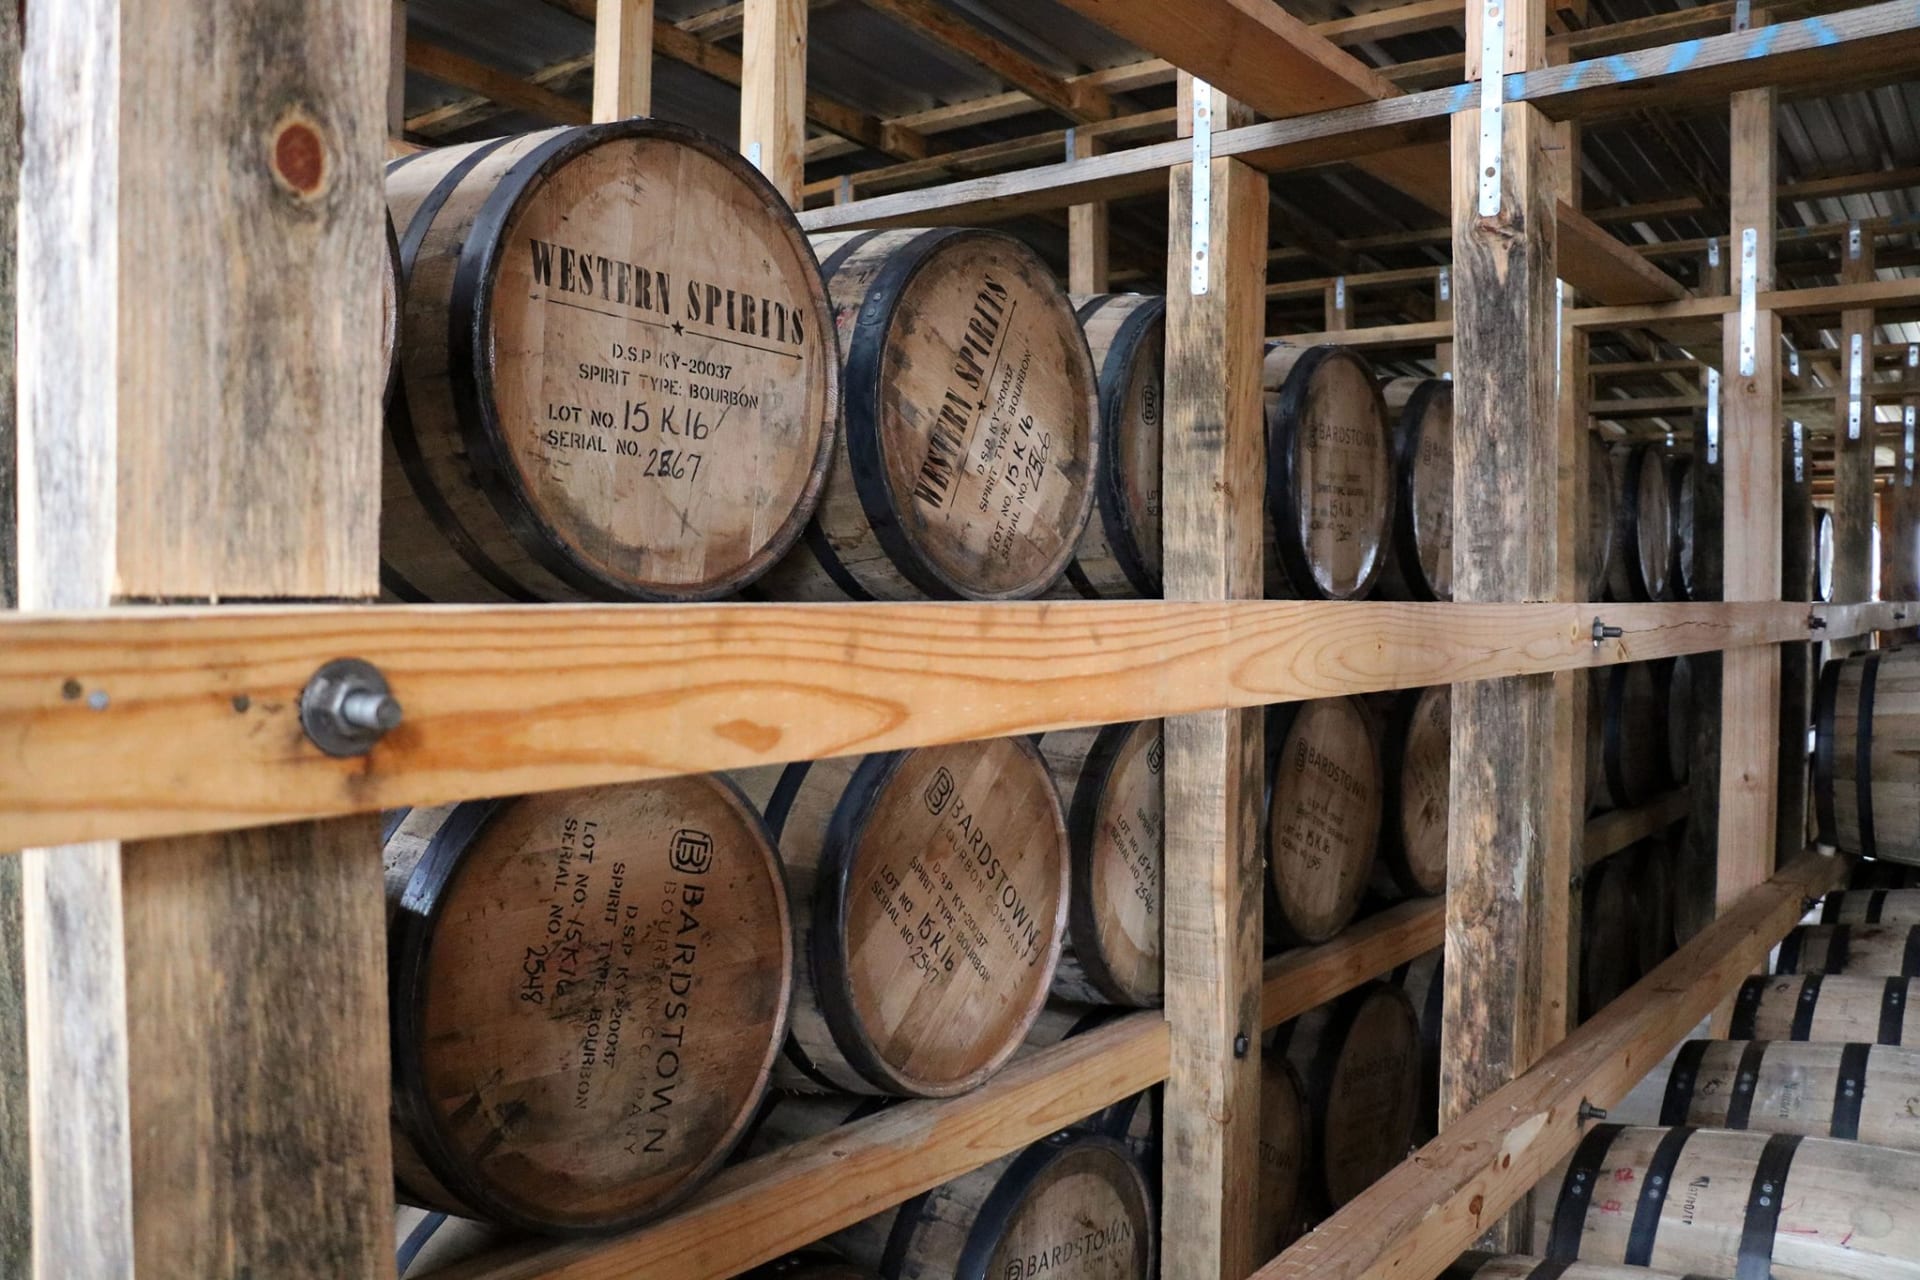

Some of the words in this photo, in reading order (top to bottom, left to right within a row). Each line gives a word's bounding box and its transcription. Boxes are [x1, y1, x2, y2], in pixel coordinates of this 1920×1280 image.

[529, 238, 670, 316] WESTERN
[687, 279, 805, 346] SPIRITS
[578, 364, 630, 386] SPIRIT
[639, 373, 683, 398] TYPE:
[689, 384, 760, 410] BOURBON
[611, 343, 652, 364] D.S.P
[658, 351, 733, 381] KY-20037
[549, 403, 583, 424] LOT
[590, 410, 618, 429] NO.
[913, 386, 973, 510] WESTERN
[954, 272, 1009, 392] SPIRITS
[547, 430, 607, 453] SERIAL
[616, 438, 642, 457] NO.
[979, 466, 999, 513] SPIRIT
[1008, 348, 1032, 417] BOURBON
[991, 521, 1005, 552] LOT
[1001, 511, 1022, 561] SERIAL
[1308, 748, 1369, 802] BARDSTOWN
[583, 820, 598, 864] LOT
[1115, 814, 1131, 836] LOT
[553, 817, 578, 893] SERIAL
[880, 863, 900, 892] LOT
[909, 856, 936, 894] SPIRIT
[950, 798, 1040, 949] BARDSTOWN
[604, 861, 626, 926] SPIRIT
[871, 881, 900, 927] SERIAL
[909, 946, 940, 983] 2547
[519, 945, 551, 1006] 2548
[643, 884, 706, 1153] BARDSTOWN
[574, 1008, 604, 1110] BOURBON
[1026, 1218, 1131, 1278] BARDSTOWN
